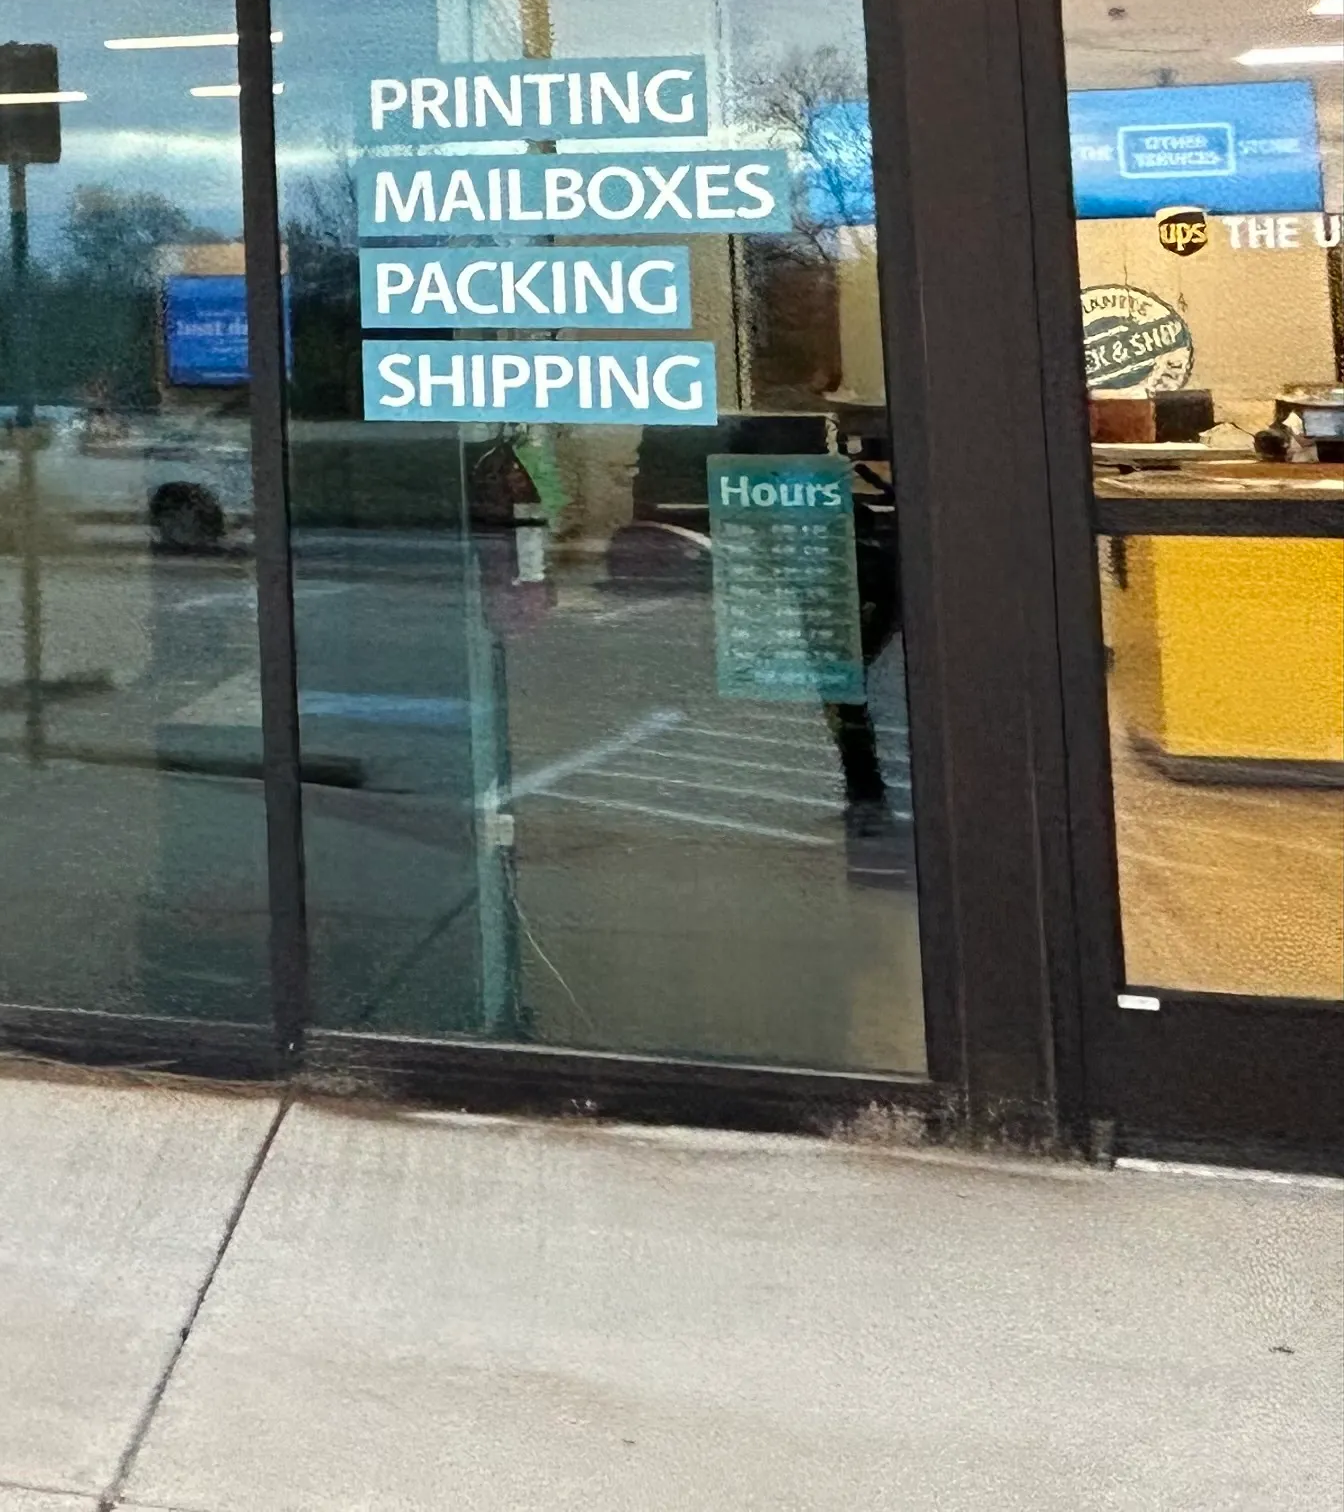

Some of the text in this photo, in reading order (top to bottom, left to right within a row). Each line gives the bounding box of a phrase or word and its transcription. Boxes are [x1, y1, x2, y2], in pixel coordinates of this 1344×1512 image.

[370, 69, 695, 131] PRINTING
[374, 163, 776, 224] MAILBOXES
[1160, 223, 1208, 251] ups
[1222, 216, 1299, 249] THE
[376, 260, 678, 315] PACKING
[378, 353, 703, 410] SHIPPING
[720, 475, 842, 507] Hours
